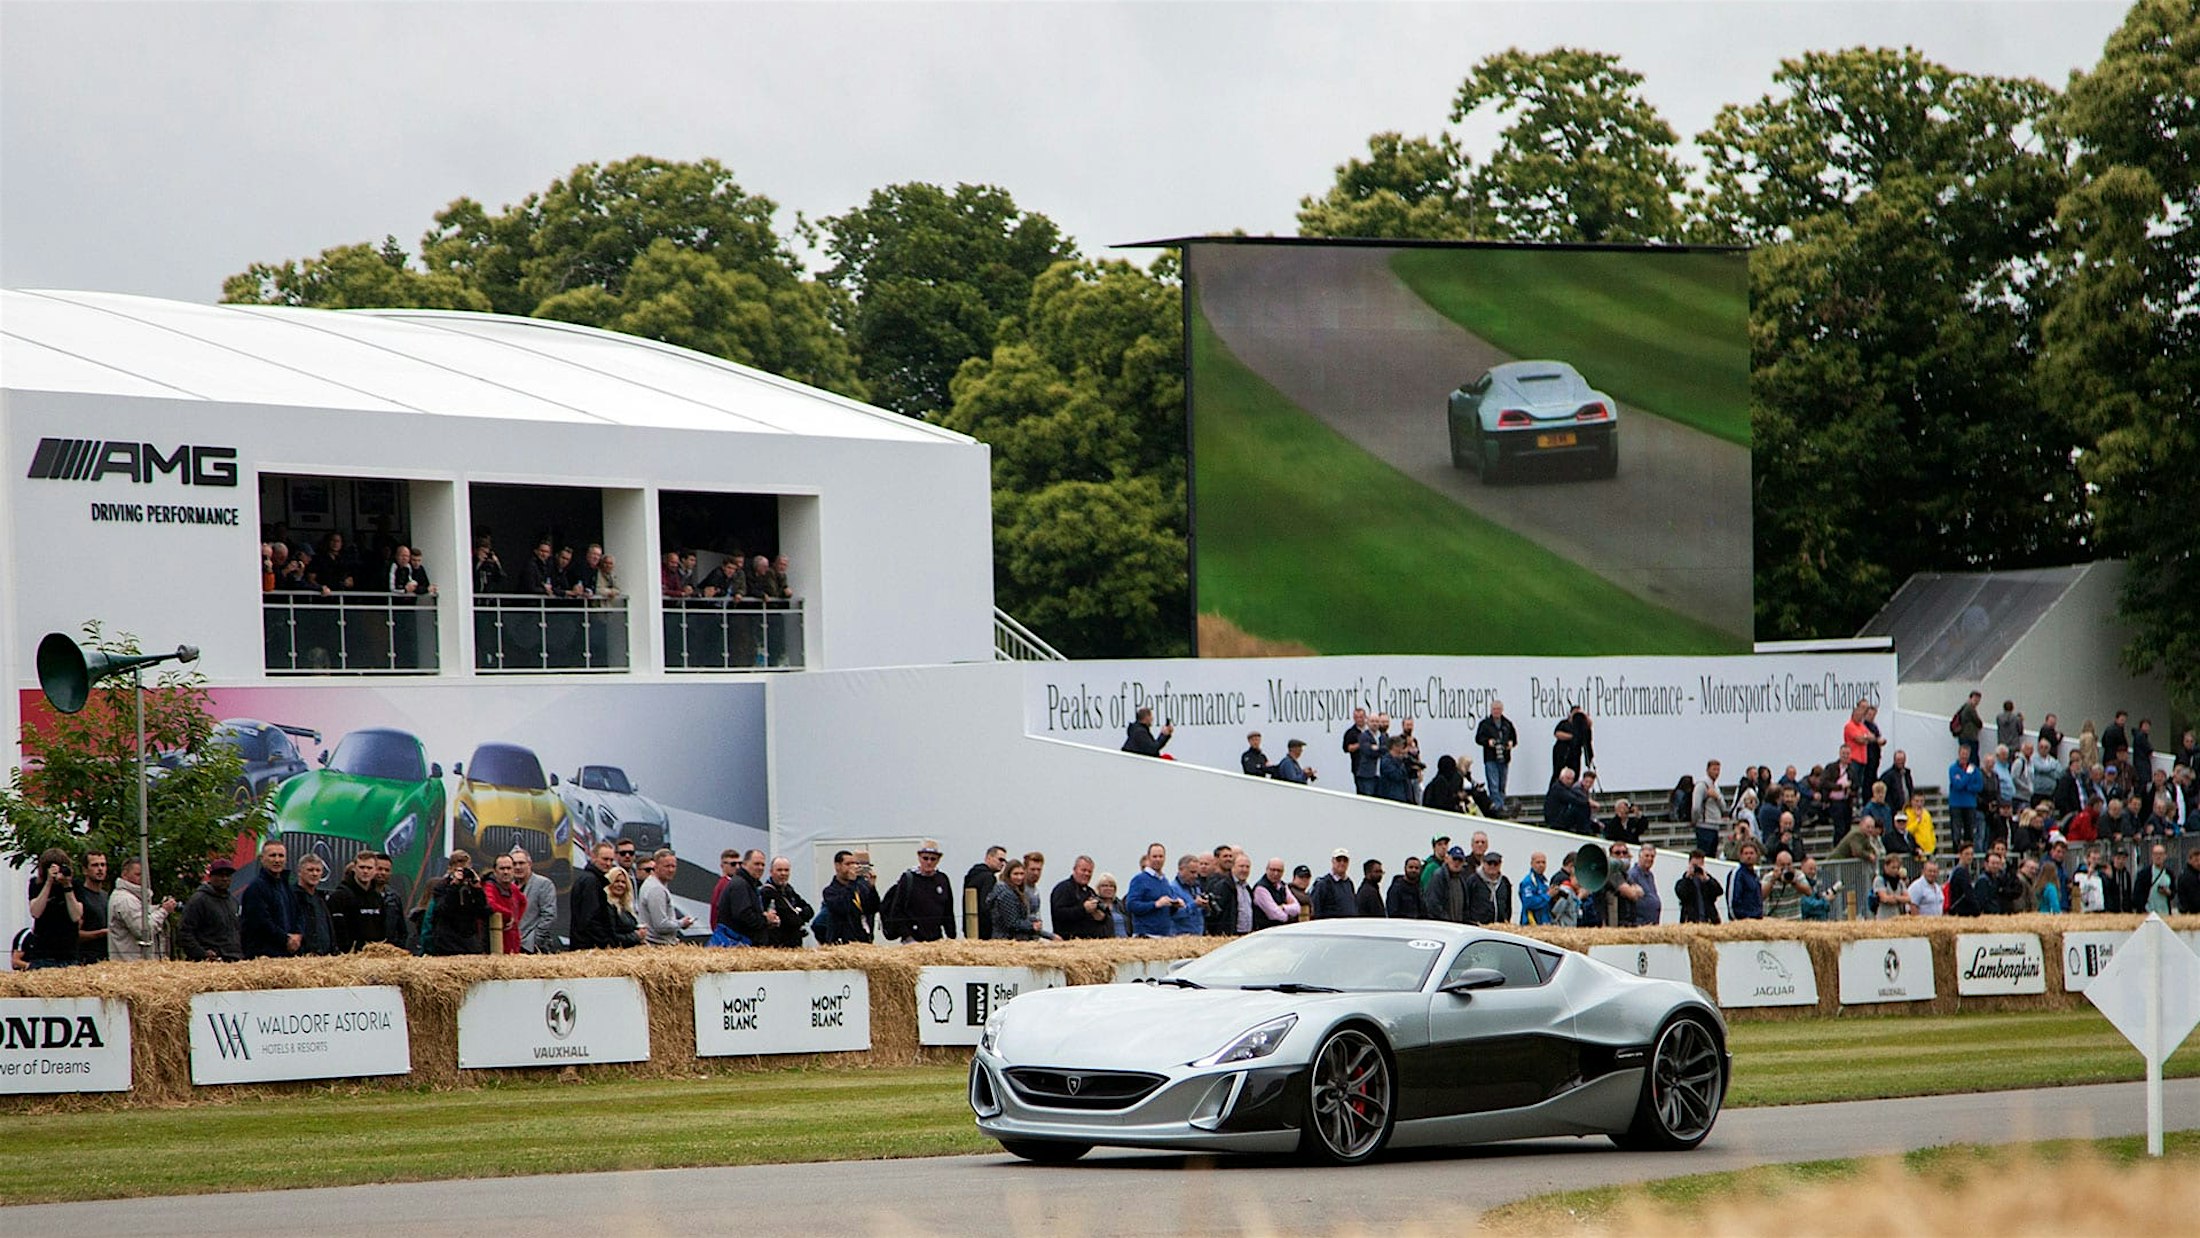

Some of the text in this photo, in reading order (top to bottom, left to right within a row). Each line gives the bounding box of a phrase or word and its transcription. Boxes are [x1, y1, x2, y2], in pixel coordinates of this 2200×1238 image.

[91, 503, 239, 526] DRIVING PERFORMANCE
[1047, 683, 1103, 731] Peaks
[1110, 681, 1127, 728] of
[1133, 680, 1245, 727] Performance
[1578, 675, 1591, 717] of
[1595, 674, 1683, 717] Performance
[1700, 673, 1781, 724] Motorsport's
[1964, 946, 2040, 986] Lamborghini
[994, 983, 1019, 1000] Shell
[1753, 985, 1795, 997] JAGUAR
[723, 998, 757, 1014] MONT
[811, 995, 843, 1011] MONT
[977, 985, 986, 1024] NEW
[256, 1013, 330, 1035] WALDORF
[723, 1014, 758, 1030] BLANC
[811, 1012, 843, 1027] BLANC
[0, 1016, 104, 1049] NDA
[533, 1045, 590, 1059] VAUXHALL
[0, 1059, 91, 1076] ver of Dreams
